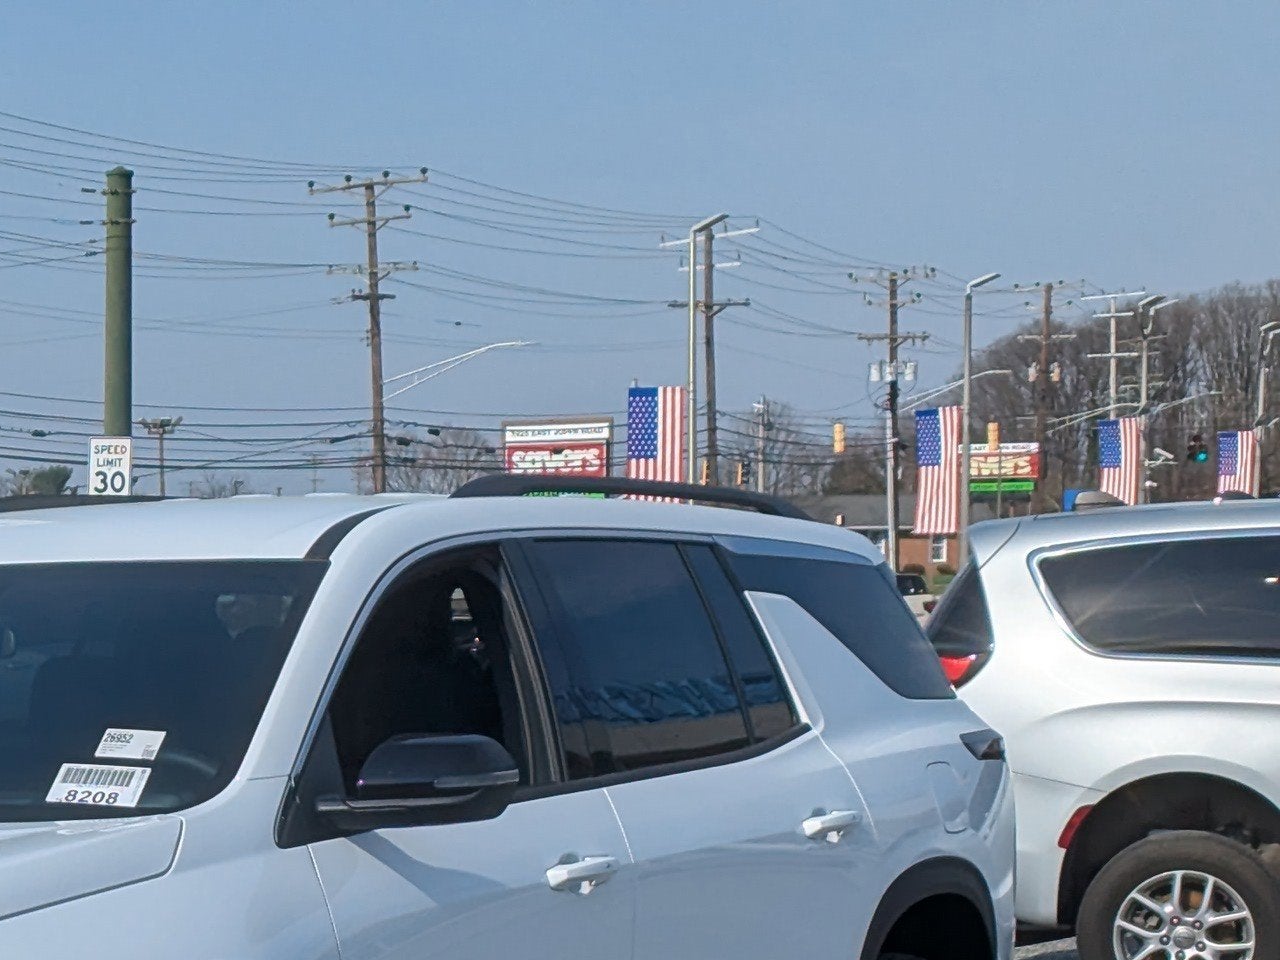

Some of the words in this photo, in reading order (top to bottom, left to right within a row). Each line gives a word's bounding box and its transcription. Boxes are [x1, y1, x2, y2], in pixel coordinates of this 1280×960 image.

[94, 444, 127, 455] SPEED
[96, 457, 123, 467] LIMIT
[94, 470, 126, 493] 30
[64, 790, 119, 805] 8208
